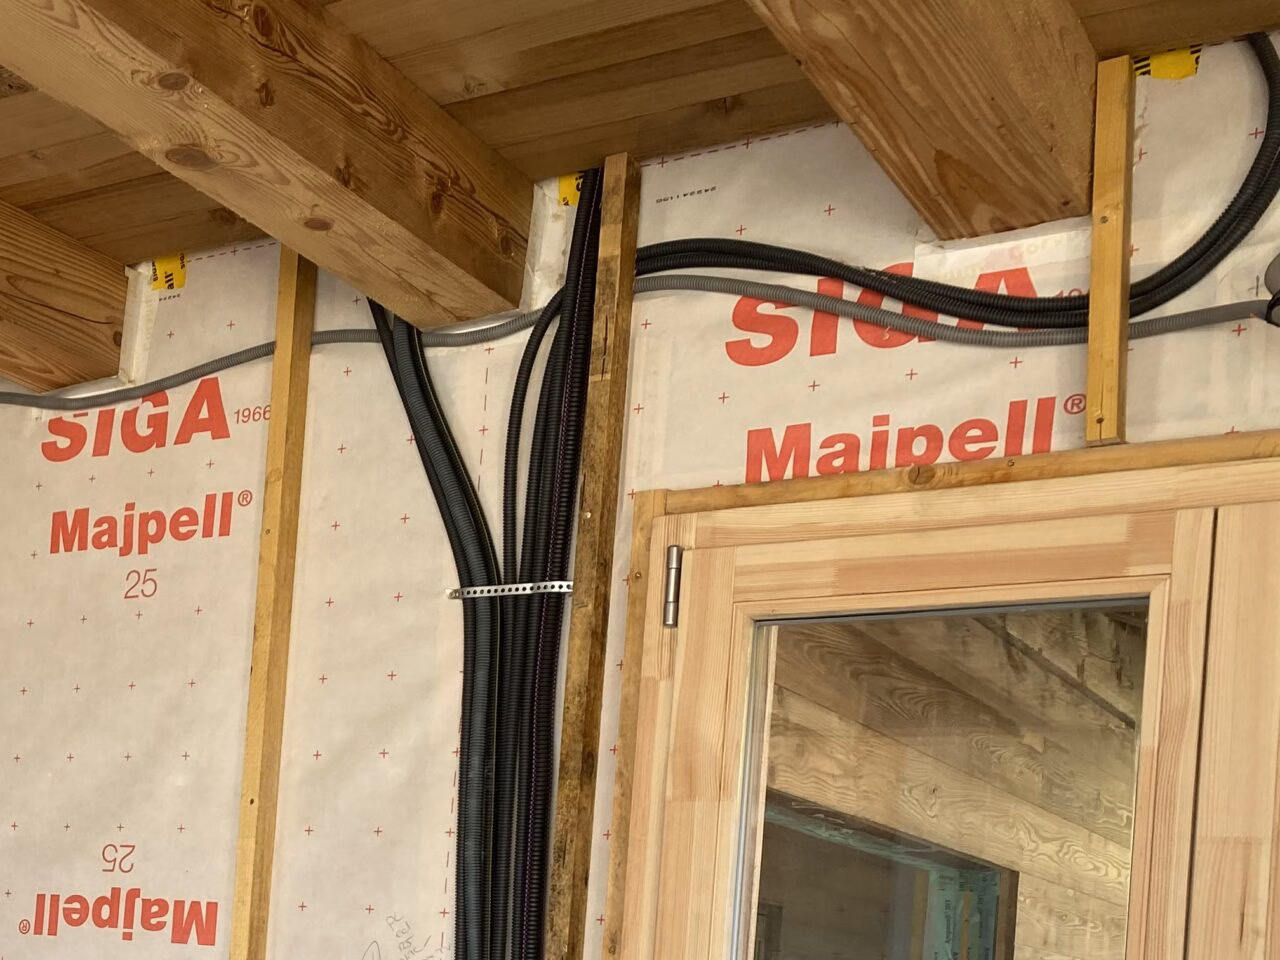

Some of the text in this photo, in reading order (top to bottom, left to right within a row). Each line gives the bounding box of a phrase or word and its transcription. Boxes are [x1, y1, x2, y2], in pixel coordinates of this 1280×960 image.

[40, 376, 231, 463] SIGA
[124, 568, 158, 600] 25
[102, 844, 135, 873] 25
